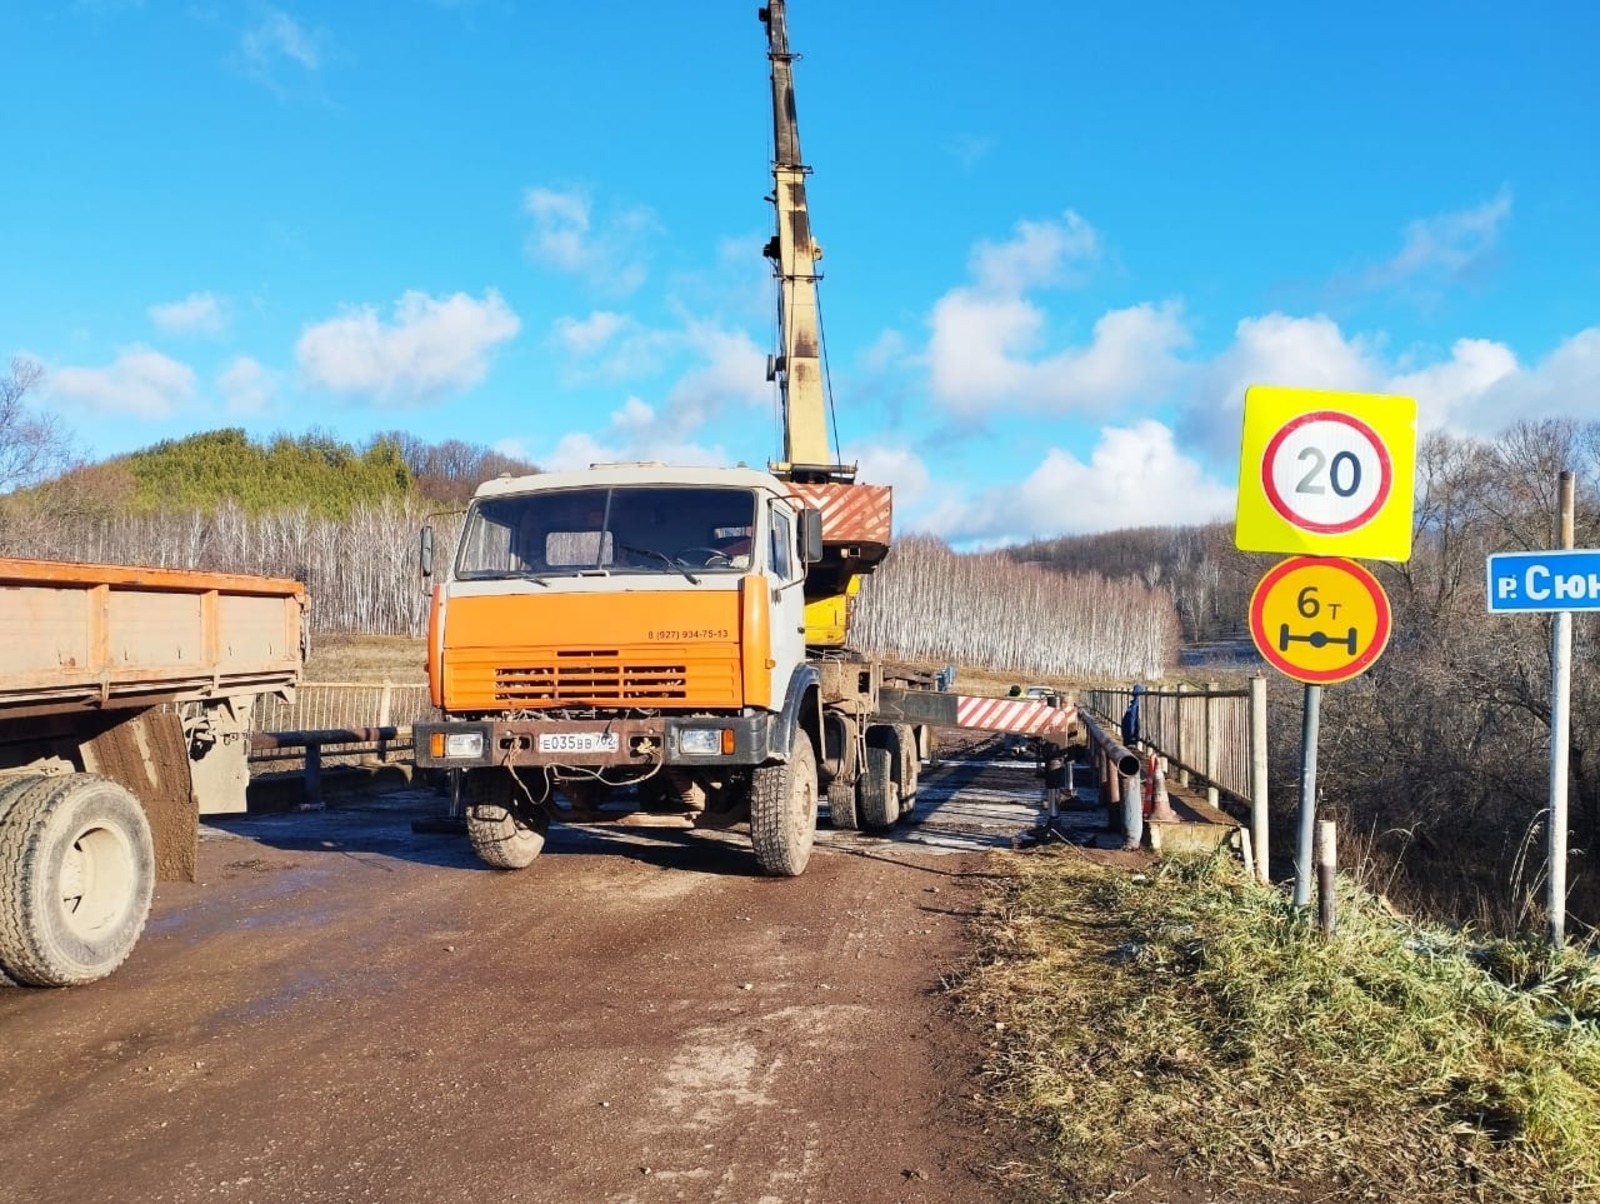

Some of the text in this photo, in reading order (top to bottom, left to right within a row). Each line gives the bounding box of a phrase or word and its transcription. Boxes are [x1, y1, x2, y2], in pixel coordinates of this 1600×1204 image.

[1295, 446, 1362, 497] 20
[1297, 586, 1320, 618] 6
[648, 629, 728, 640] 8 (927) 934-75-13
